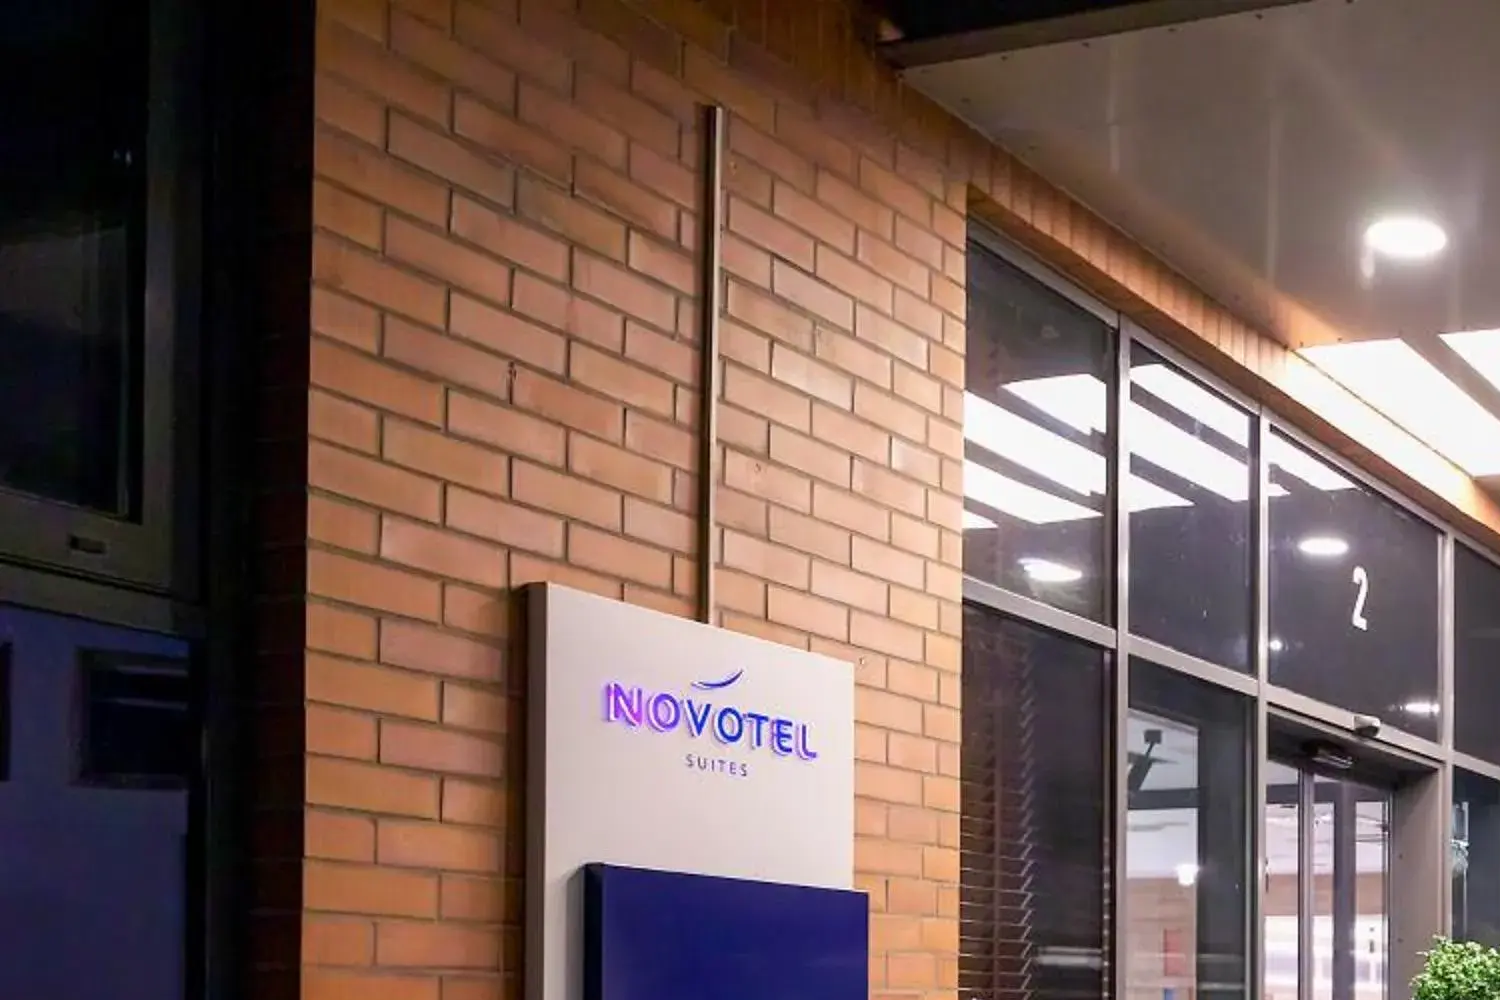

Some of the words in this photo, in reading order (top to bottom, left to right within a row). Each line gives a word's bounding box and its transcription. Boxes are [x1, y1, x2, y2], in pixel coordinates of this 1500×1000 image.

[1352, 565, 1369, 631] 2
[606, 682, 818, 760] NOVOTEL
[685, 753, 748, 778] SUITES
